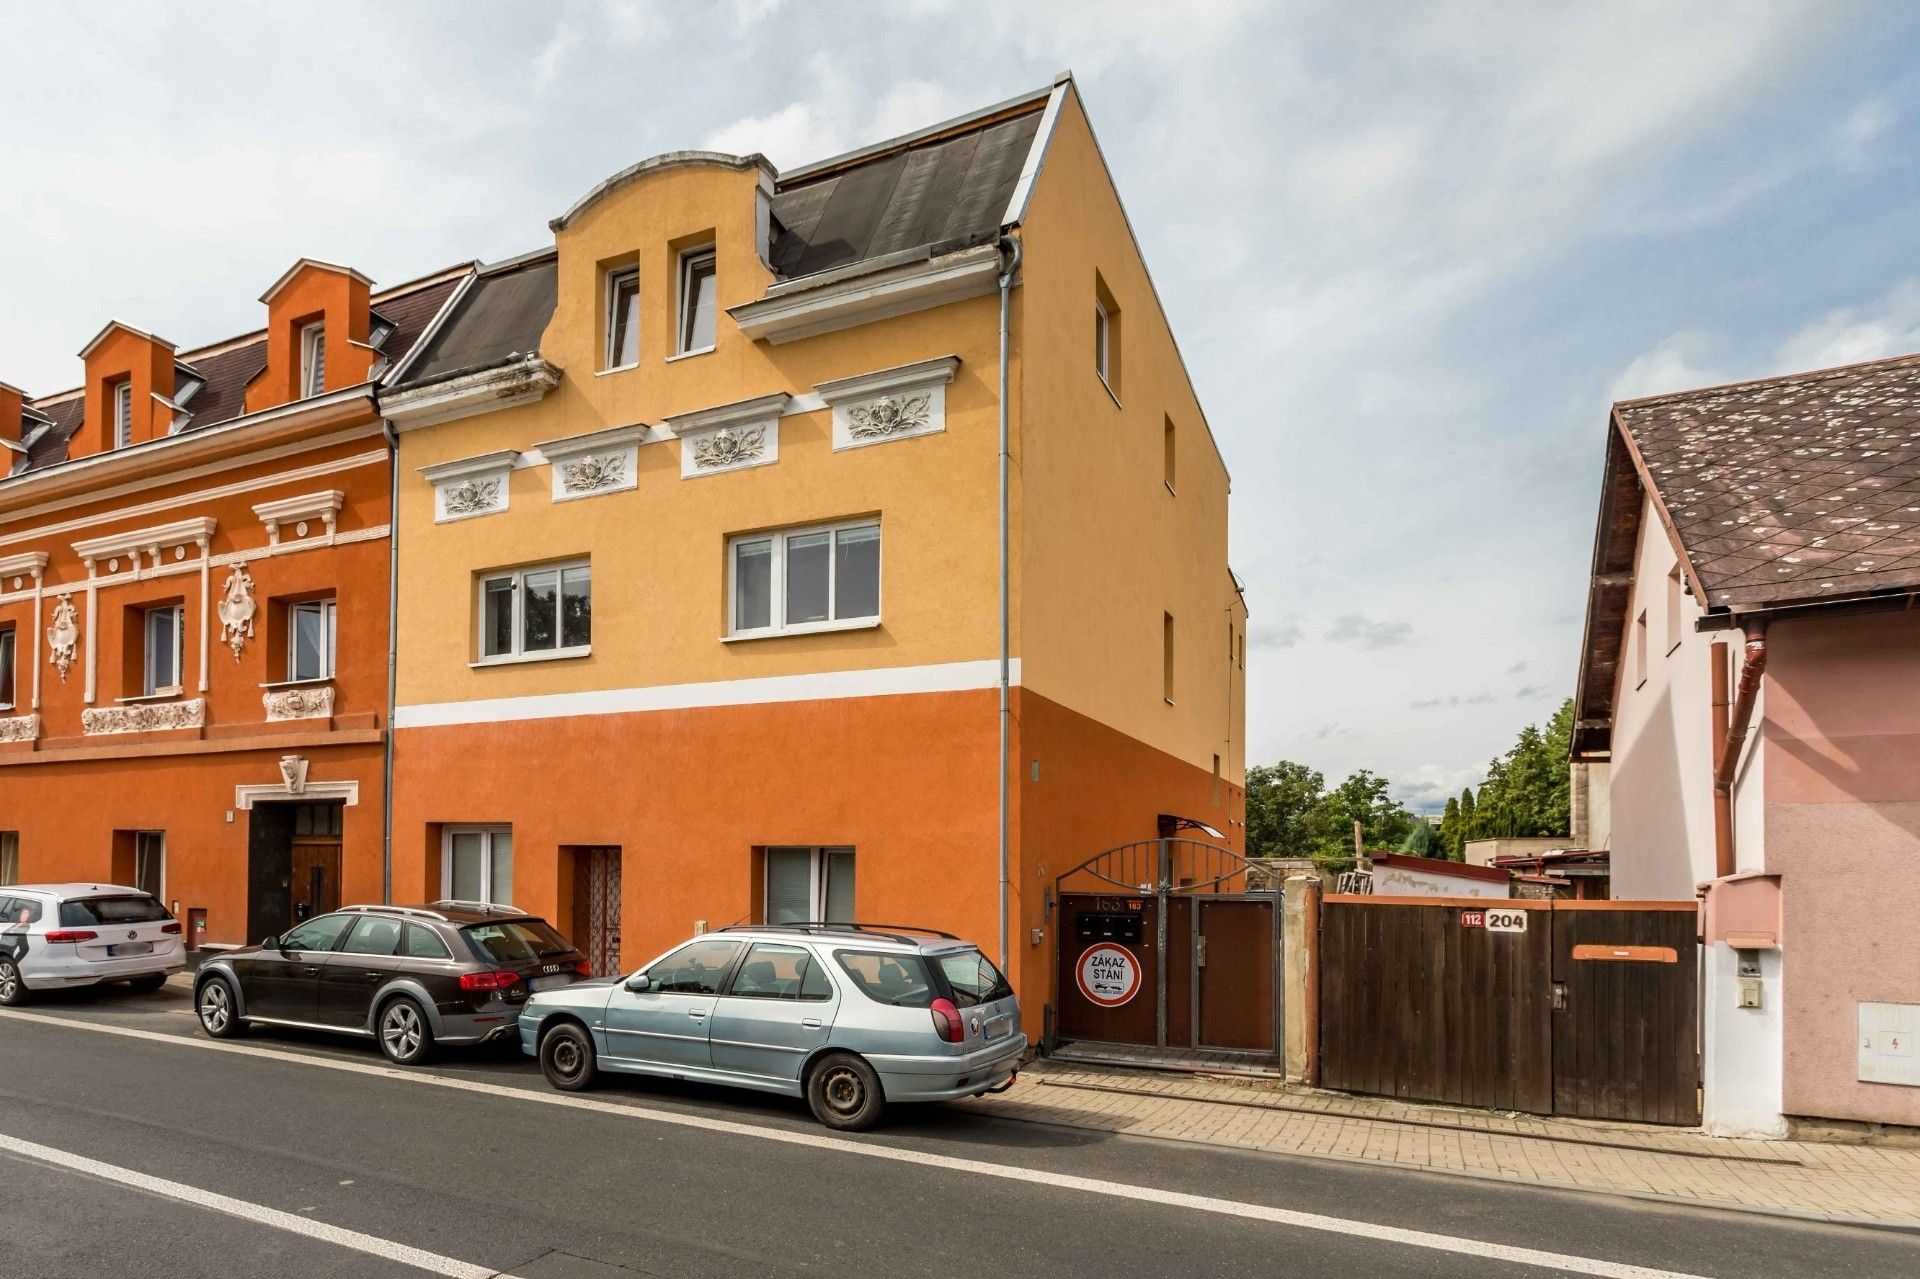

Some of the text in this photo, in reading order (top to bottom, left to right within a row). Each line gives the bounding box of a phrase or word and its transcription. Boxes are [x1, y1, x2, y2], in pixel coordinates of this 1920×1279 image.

[1465, 914, 1482, 925] 112
[1489, 914, 1524, 928] 204
[1091, 954, 1125, 968] ZÁKAZ
[1093, 966, 1123, 980] STÁNÍ
